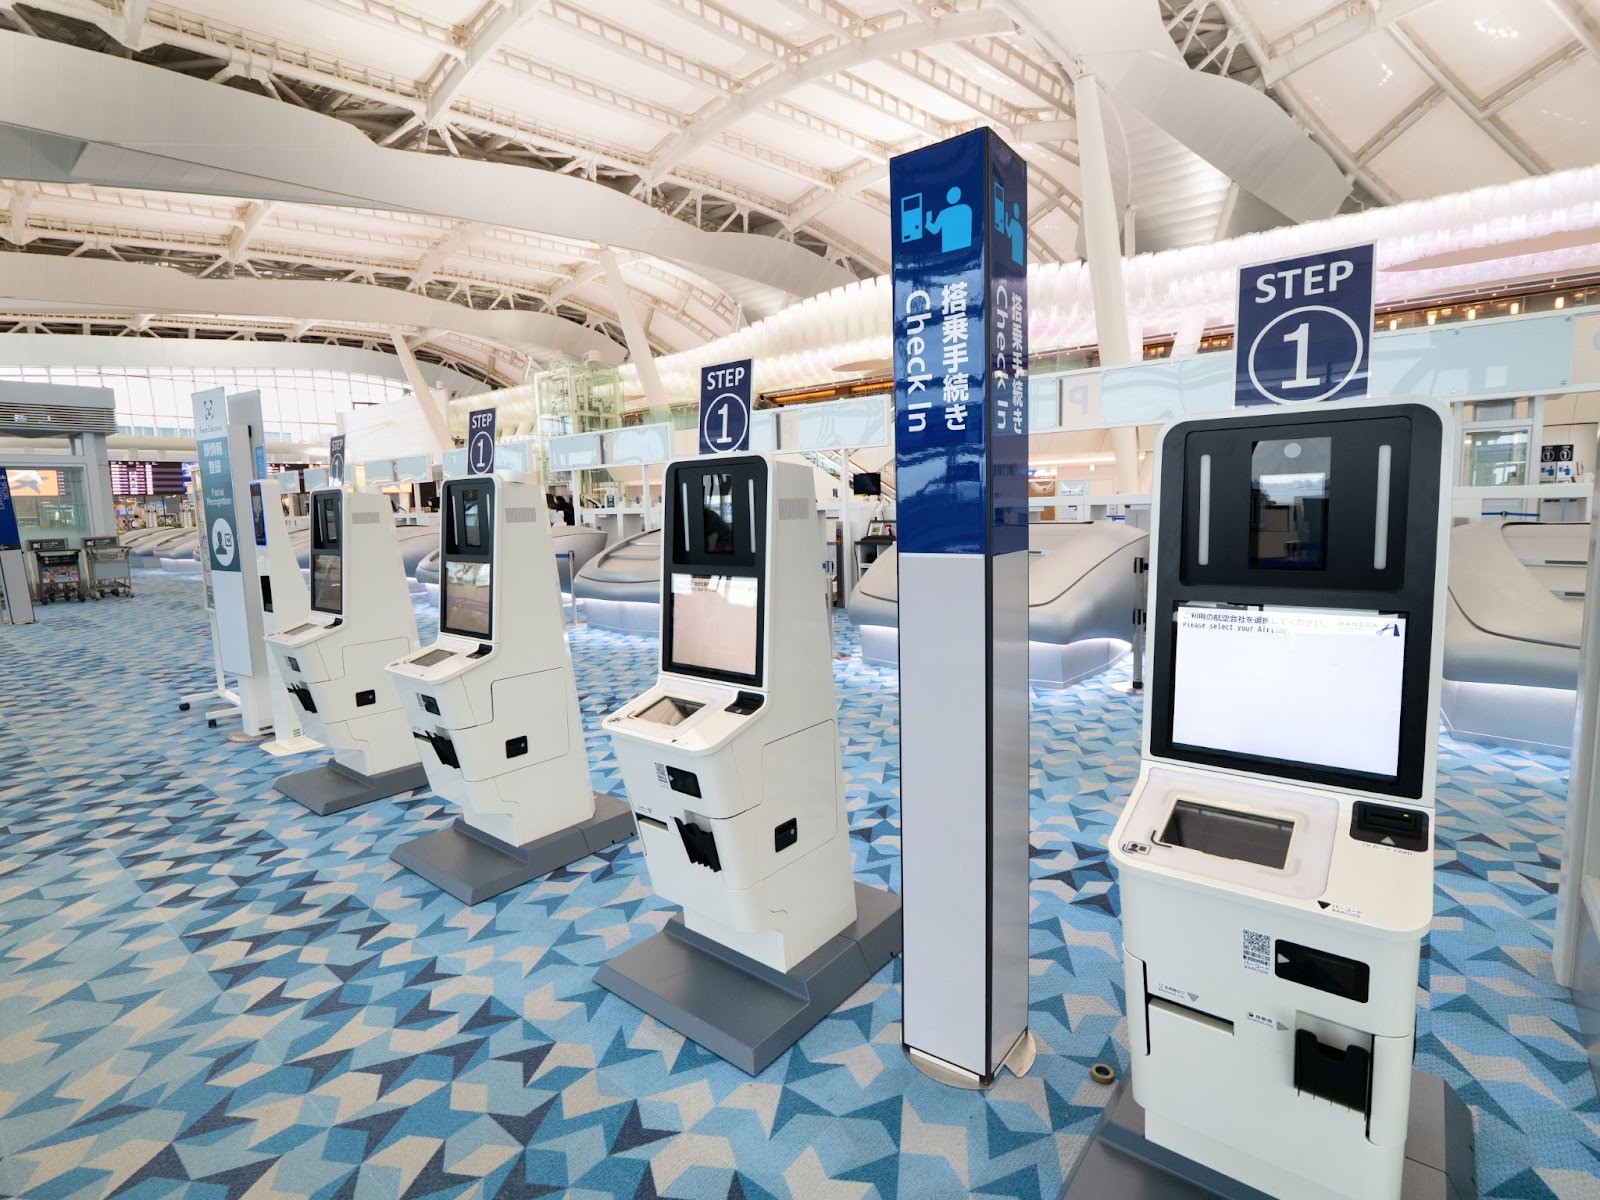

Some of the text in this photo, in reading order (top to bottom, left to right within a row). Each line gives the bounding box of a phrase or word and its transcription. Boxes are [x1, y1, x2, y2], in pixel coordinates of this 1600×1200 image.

[1255, 260, 1353, 303] STEP
[906, 290, 932, 432] Check In
[941, 281, 969, 431] 搭乗手続き
[996, 285, 1008, 430] Check In
[1011, 292, 1023, 435] 搭乗手続き
[1281, 323, 1320, 390] 1
[707, 367, 745, 390] STEP
[471, 413, 492, 429] STEP
[716, 403, 732, 443] 1
[331, 439, 344, 451] STEP
[476, 438, 485, 467] 1
[206, 497, 232, 508] Recognition
[211, 488, 224, 498] Facial
[1183, 621, 1206, 630] Please
[1209, 623, 1234, 632] select
[1237, 625, 1254, 633] your
